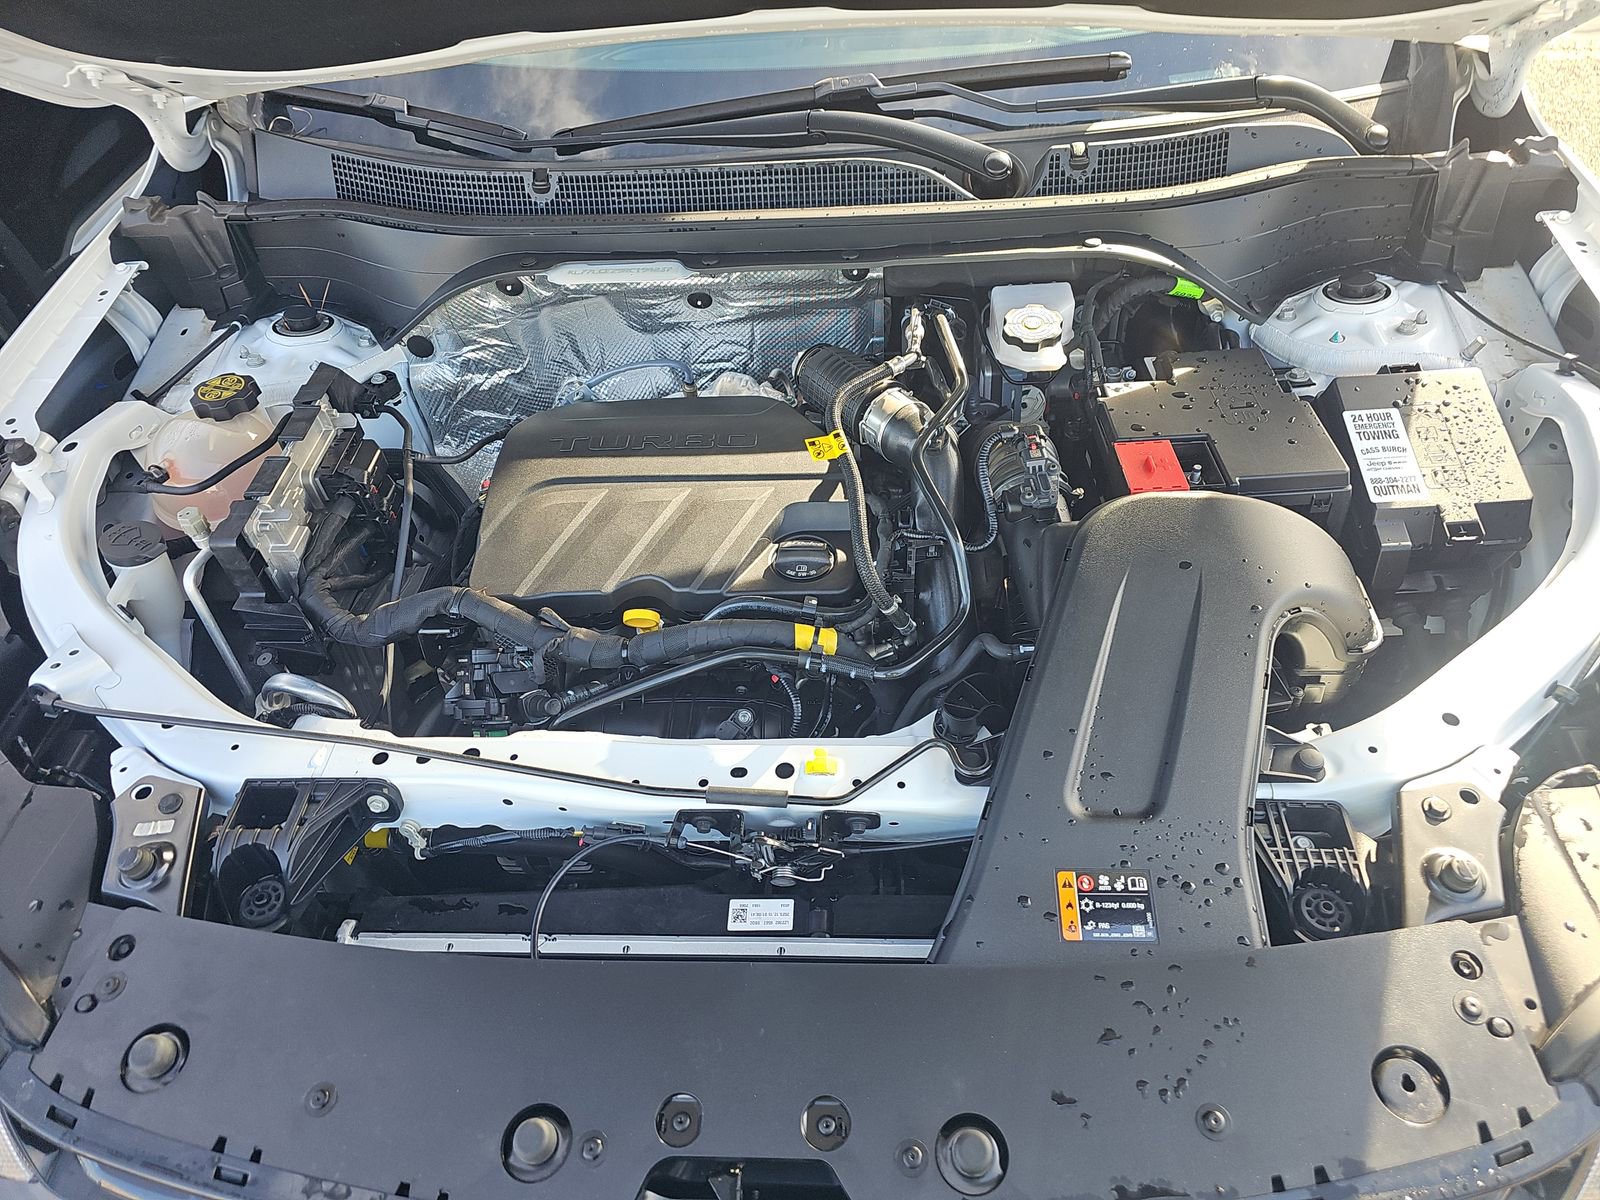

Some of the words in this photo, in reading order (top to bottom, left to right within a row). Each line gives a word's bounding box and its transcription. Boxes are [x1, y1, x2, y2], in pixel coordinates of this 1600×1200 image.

[1351, 414, 1364, 422] 24
[1366, 412, 1393, 422] HOUR
[1354, 422, 1396, 430] EMERGENCY
[1356, 430, 1400, 441] TOWING
[550, 432, 759, 452] TURBO
[1360, 446, 1380, 455] CASS
[1373, 484, 1420, 497] QUITMAN
